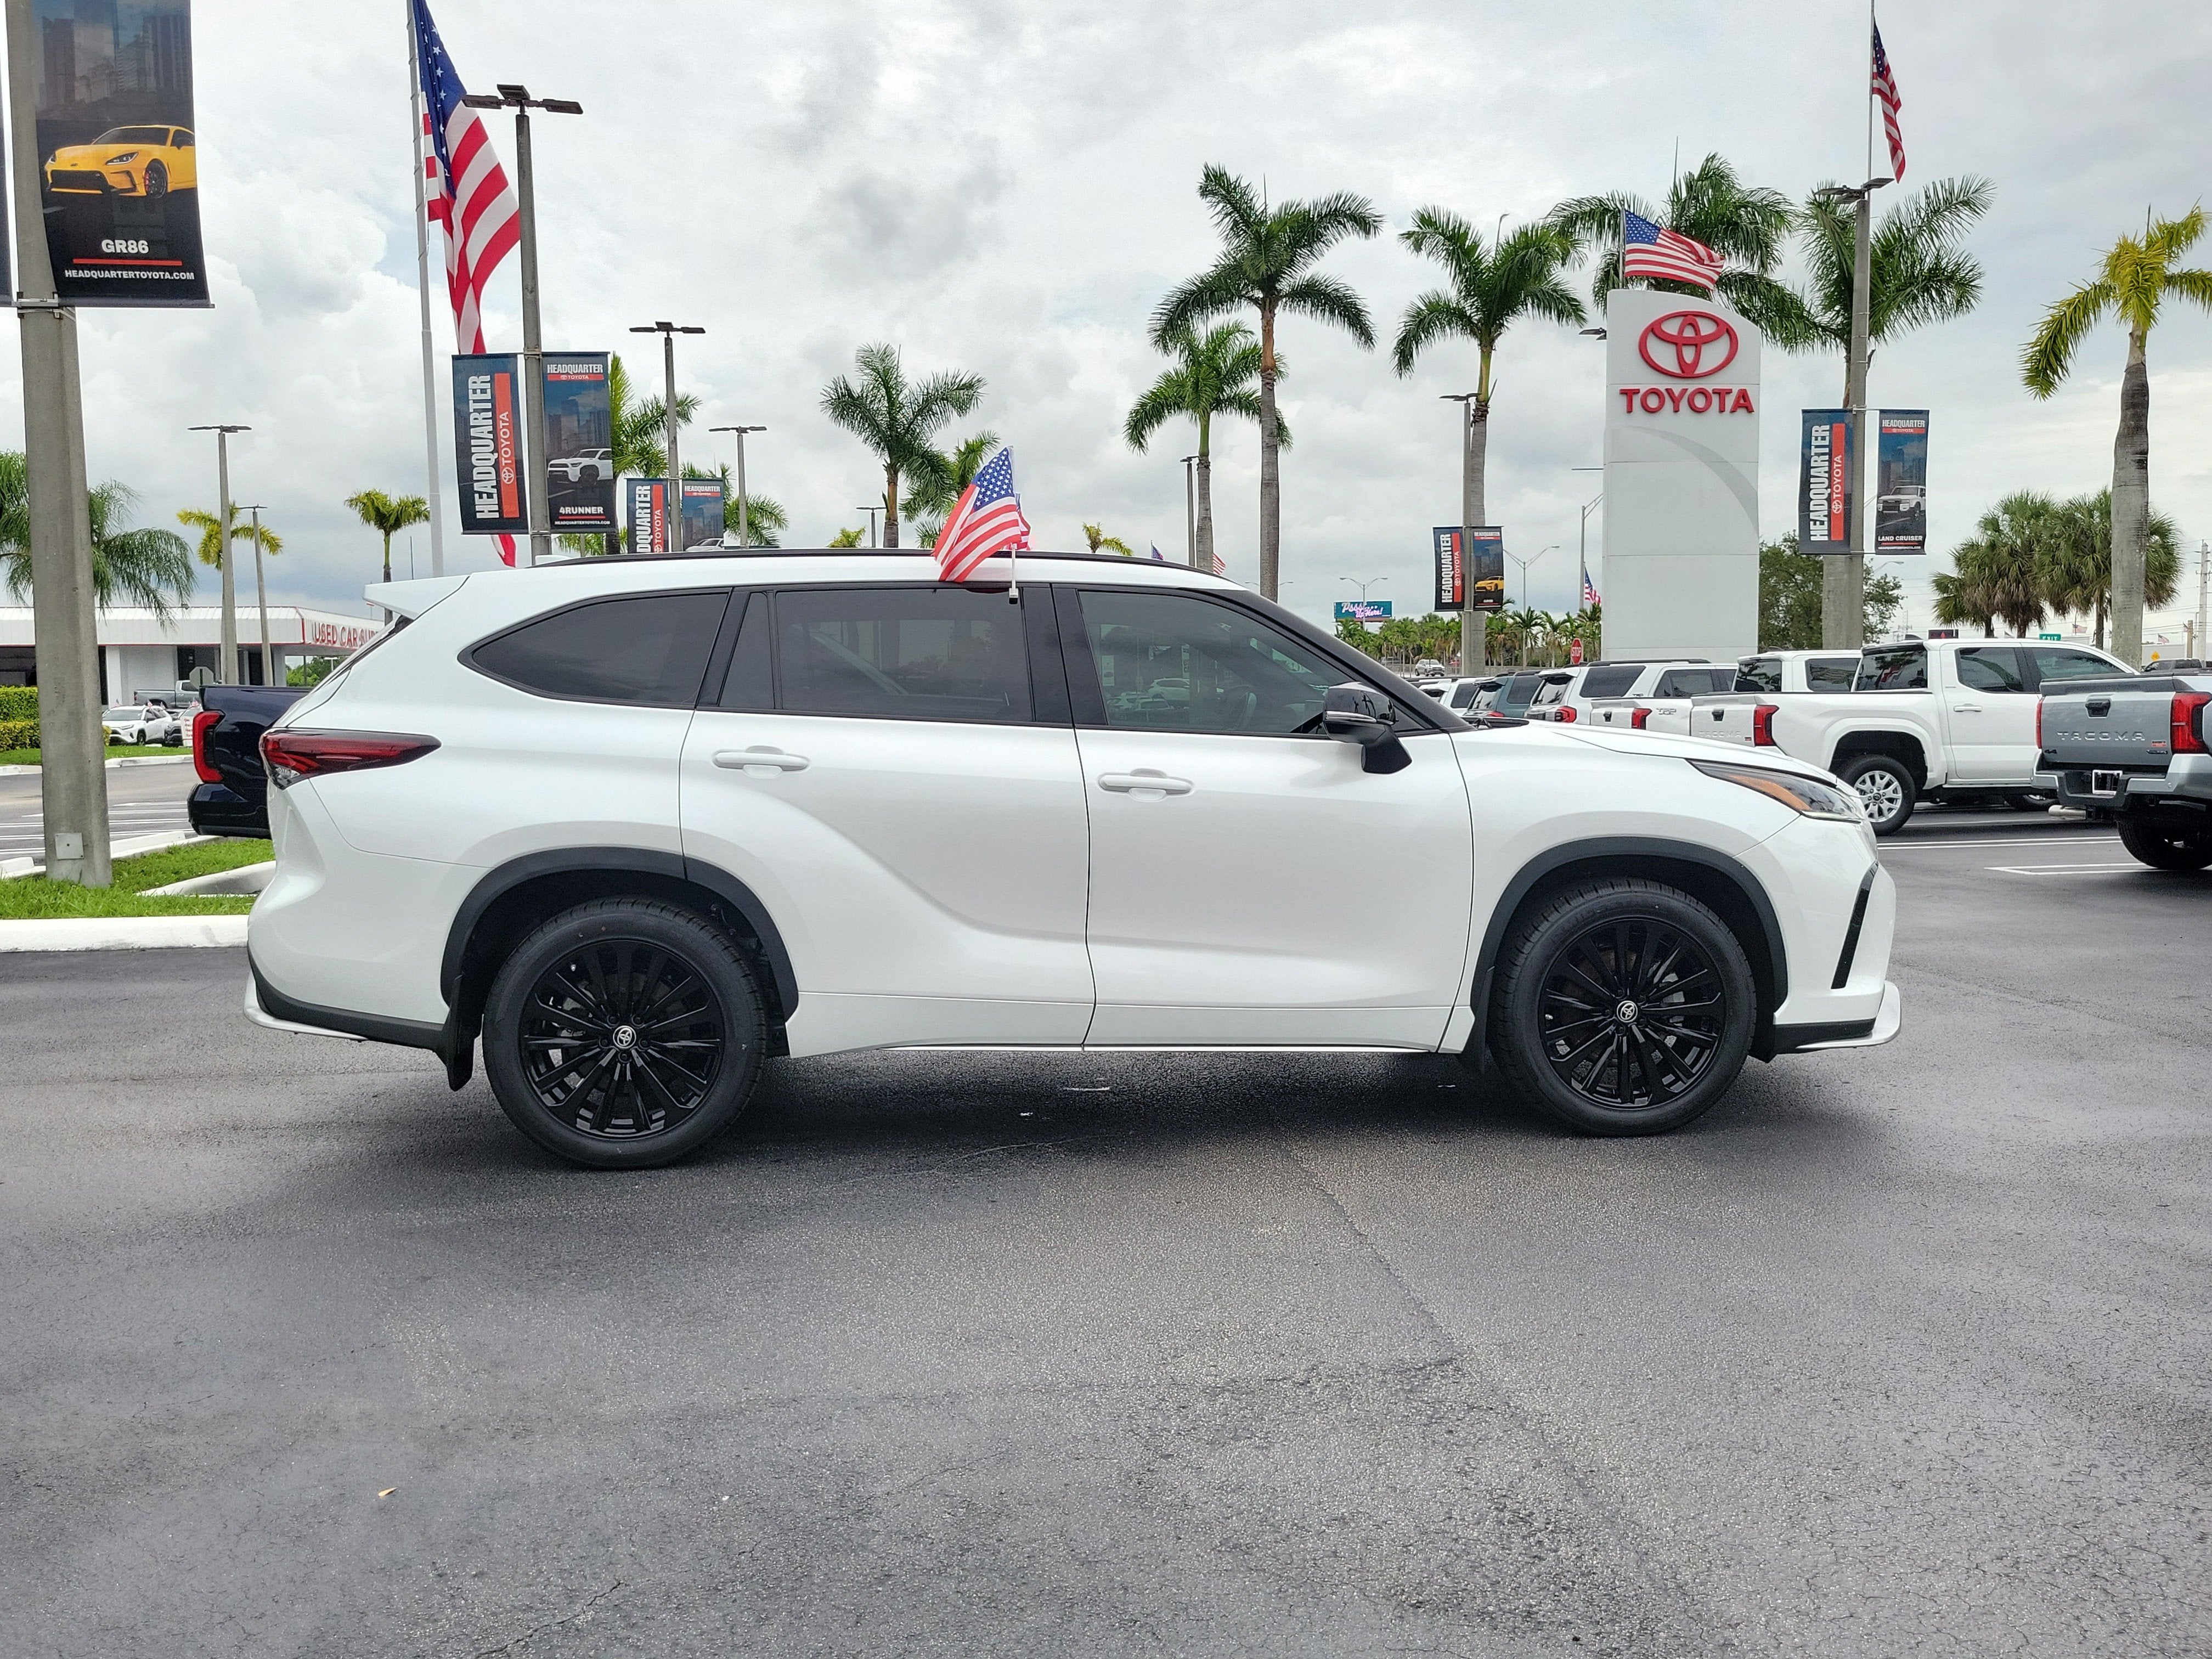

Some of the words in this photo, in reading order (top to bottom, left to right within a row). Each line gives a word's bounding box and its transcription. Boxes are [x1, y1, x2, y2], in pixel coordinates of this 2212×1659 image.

[101, 239, 149, 254] GR86
[65, 269, 195, 280] HEADQUARTERTOYOTA.COM
[547, 364, 603, 375] HEADQUARTER
[1619, 387, 1754, 414] TOYOTA
[1882, 419, 1925, 428] HEADQUARTER
[468, 375, 499, 519] HEADQUARTER
[500, 411, 512, 466] TOYOTA
[1809, 425, 1831, 541] HEADQUARTER
[1833, 455, 1842, 499] TOYOTA
[559, 506, 604, 515] 4RUNNER
[636, 485, 653, 552] DQUARTER
[1440, 534, 1454, 603] HEADQUARTER
[313, 622, 338, 645] USED
[340, 626, 358, 648] CAR
[1571, 646, 1582, 657] STOP
[2057, 731, 2146, 741] TACOMA
